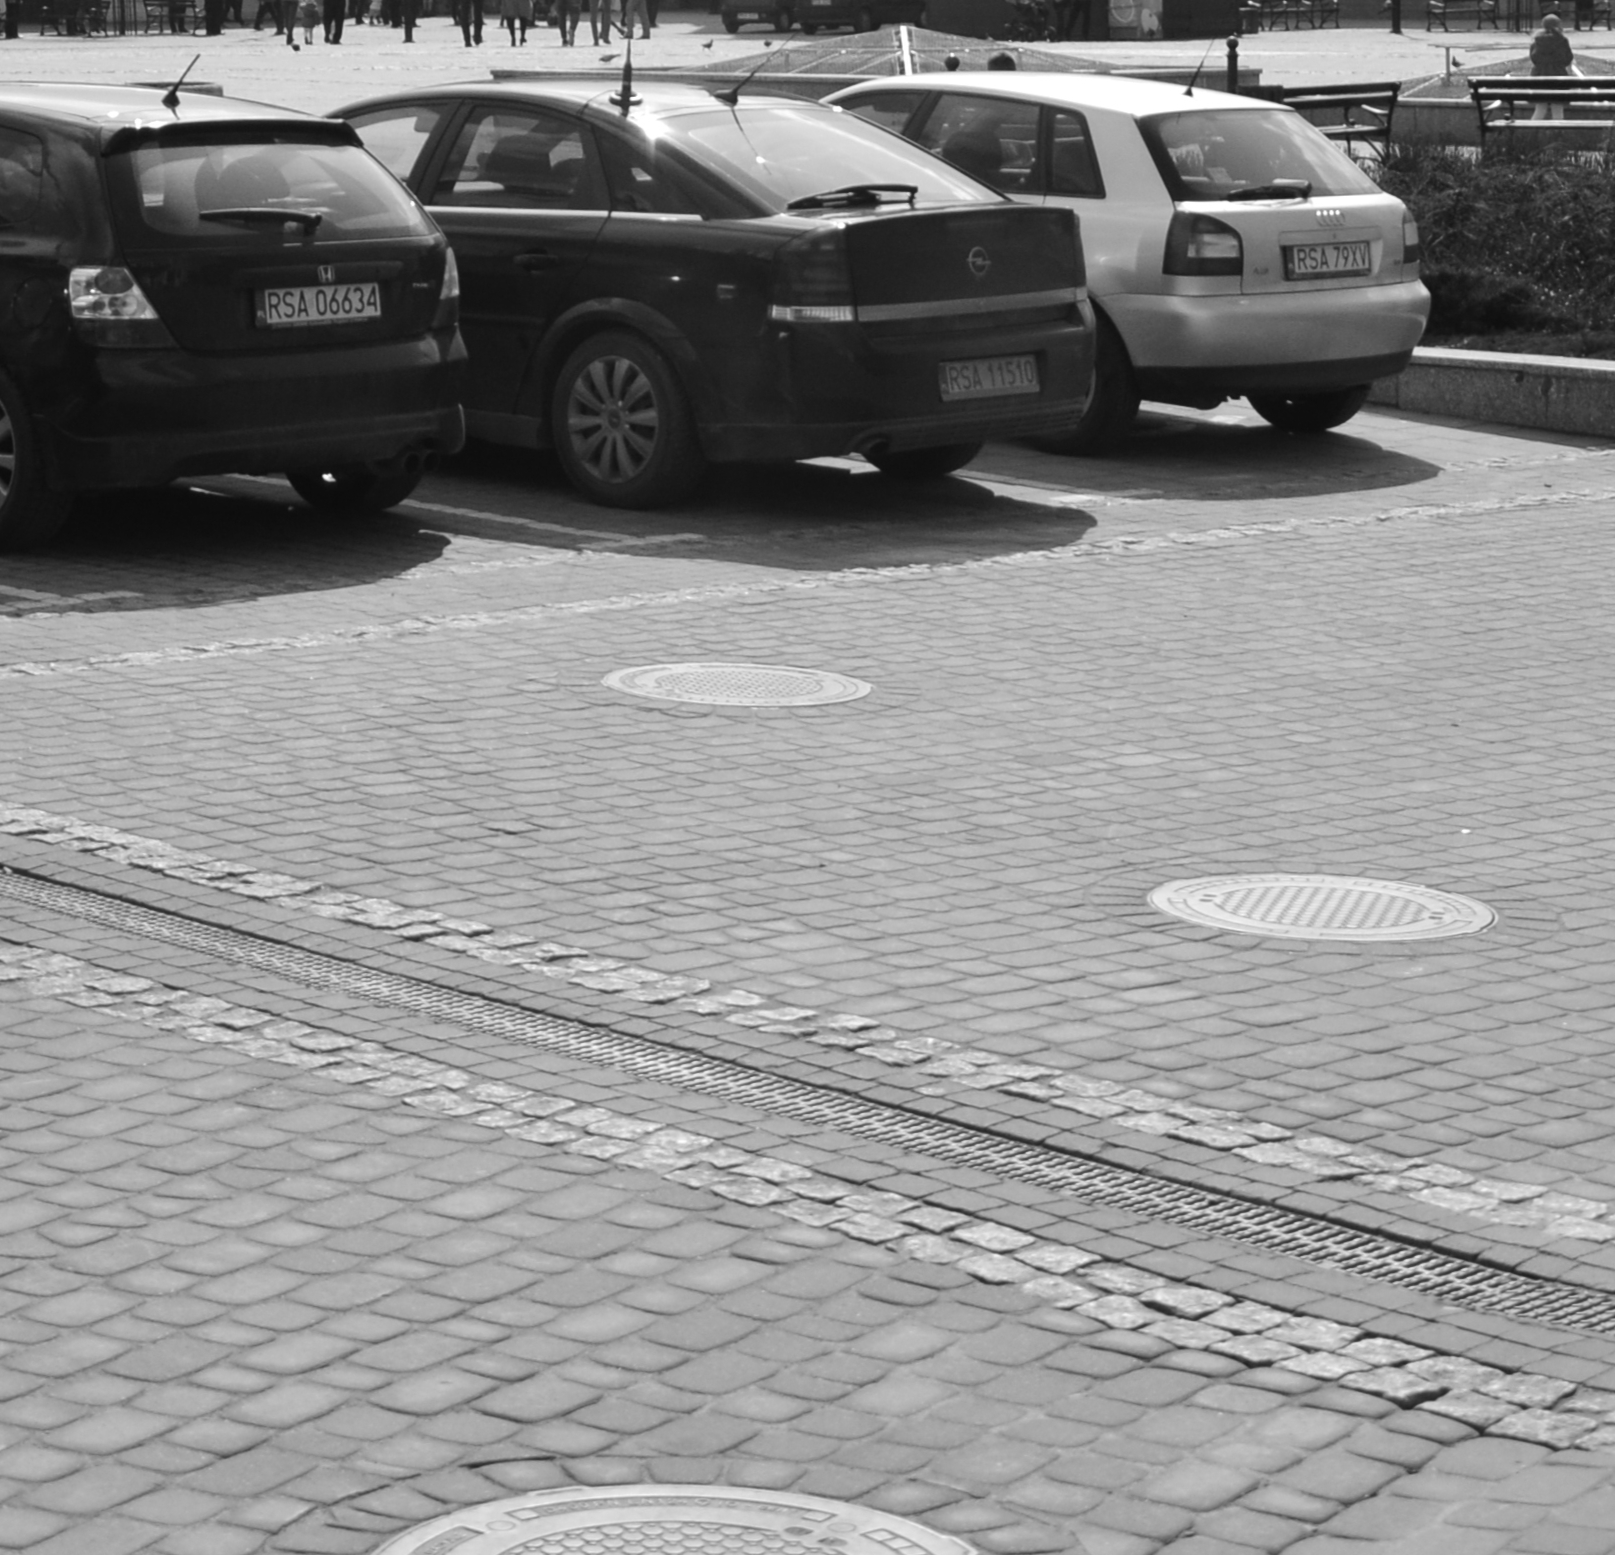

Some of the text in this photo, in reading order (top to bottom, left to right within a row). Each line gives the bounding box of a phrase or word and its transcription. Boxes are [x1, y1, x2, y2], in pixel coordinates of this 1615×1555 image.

[1297, 245, 1367, 270] RSA 79XV
[267, 286, 378, 320] RSA 06634
[948, 360, 1035, 391] RSA 11510
